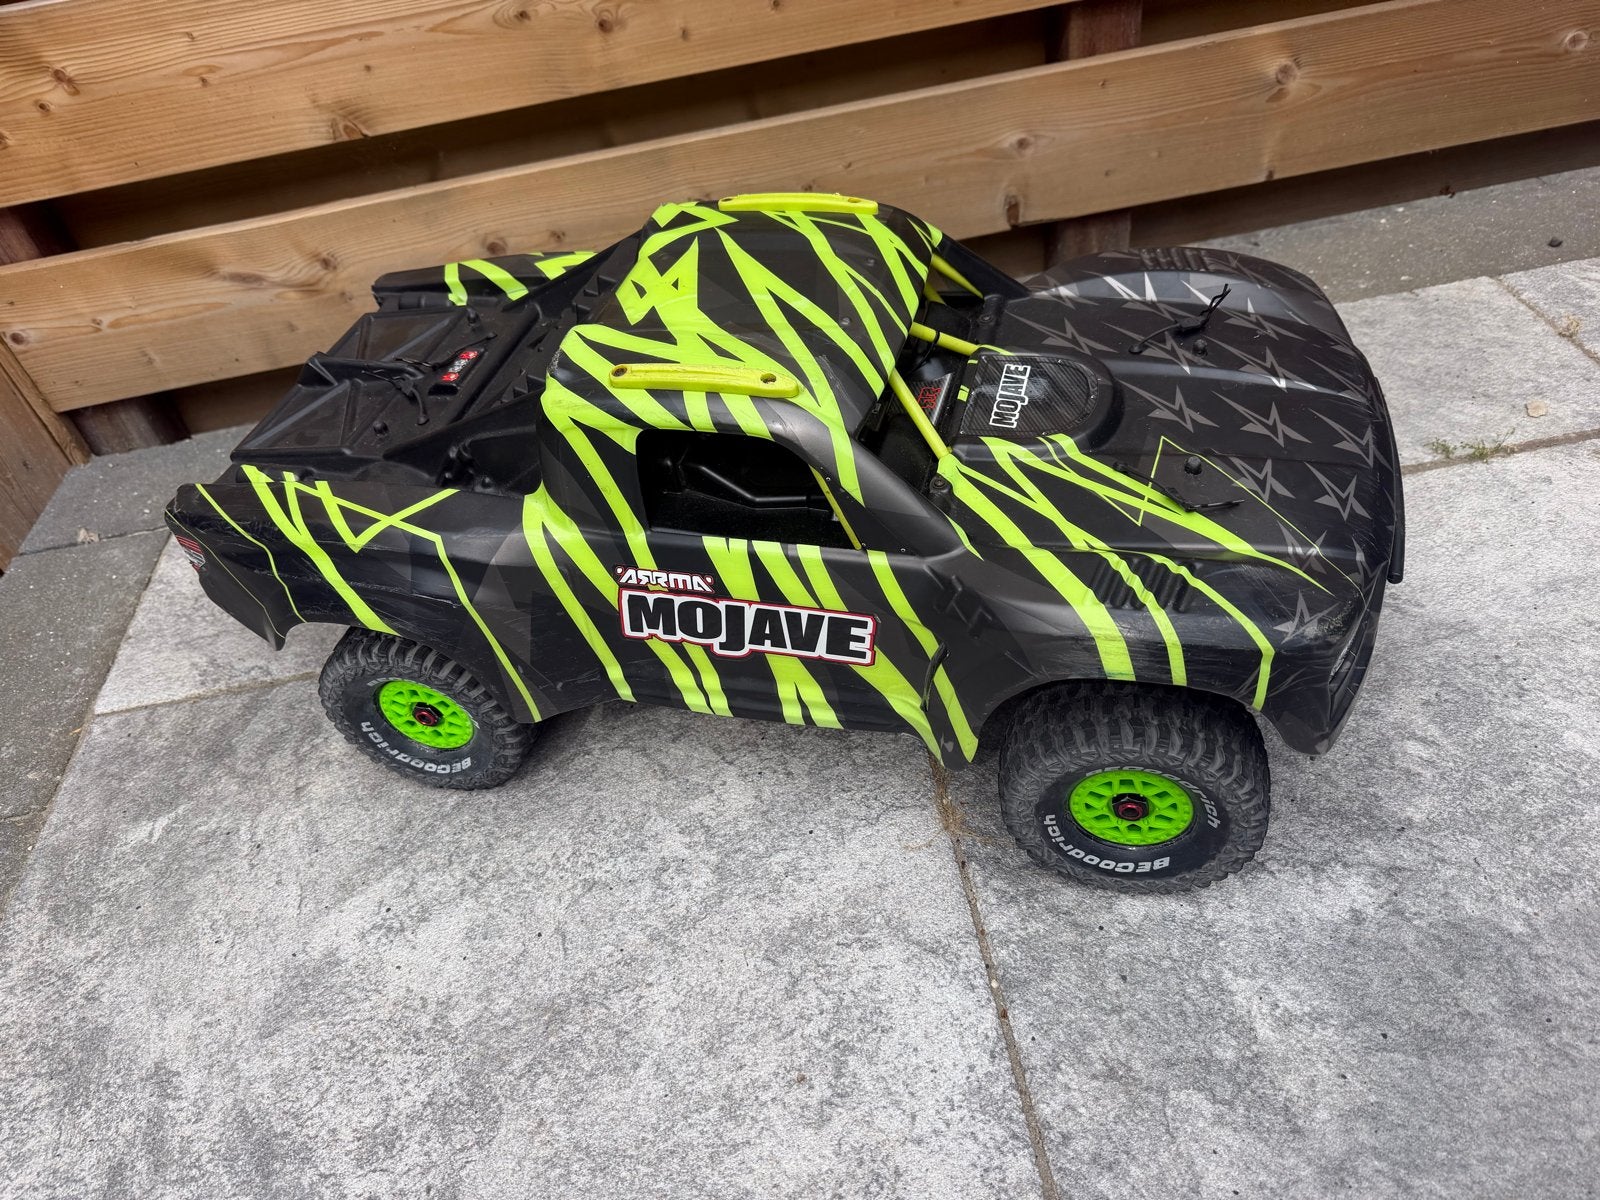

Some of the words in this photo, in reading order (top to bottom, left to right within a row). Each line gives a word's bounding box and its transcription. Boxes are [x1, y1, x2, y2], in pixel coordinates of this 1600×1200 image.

[989, 363, 1031, 429] MOJAVE
[616, 566, 713, 592] ARRMA
[625, 592, 871, 661] MOJAVE
